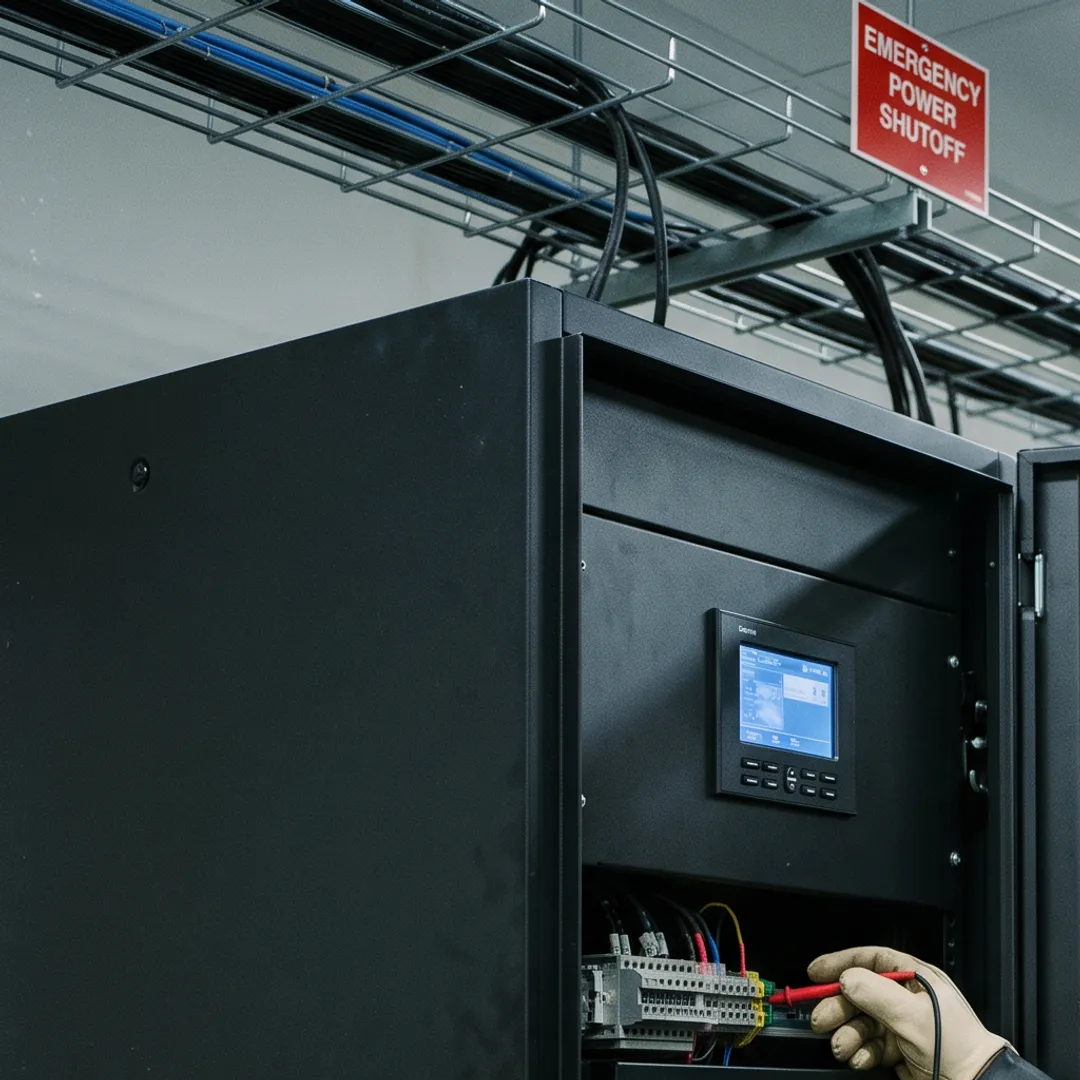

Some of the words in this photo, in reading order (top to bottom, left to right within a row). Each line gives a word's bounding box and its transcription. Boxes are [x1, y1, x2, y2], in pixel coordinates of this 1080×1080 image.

[864, 24, 981, 107] EMERGENCY
[889, 72, 957, 129] POWER
[879, 102, 966, 164] SHUTOFF
